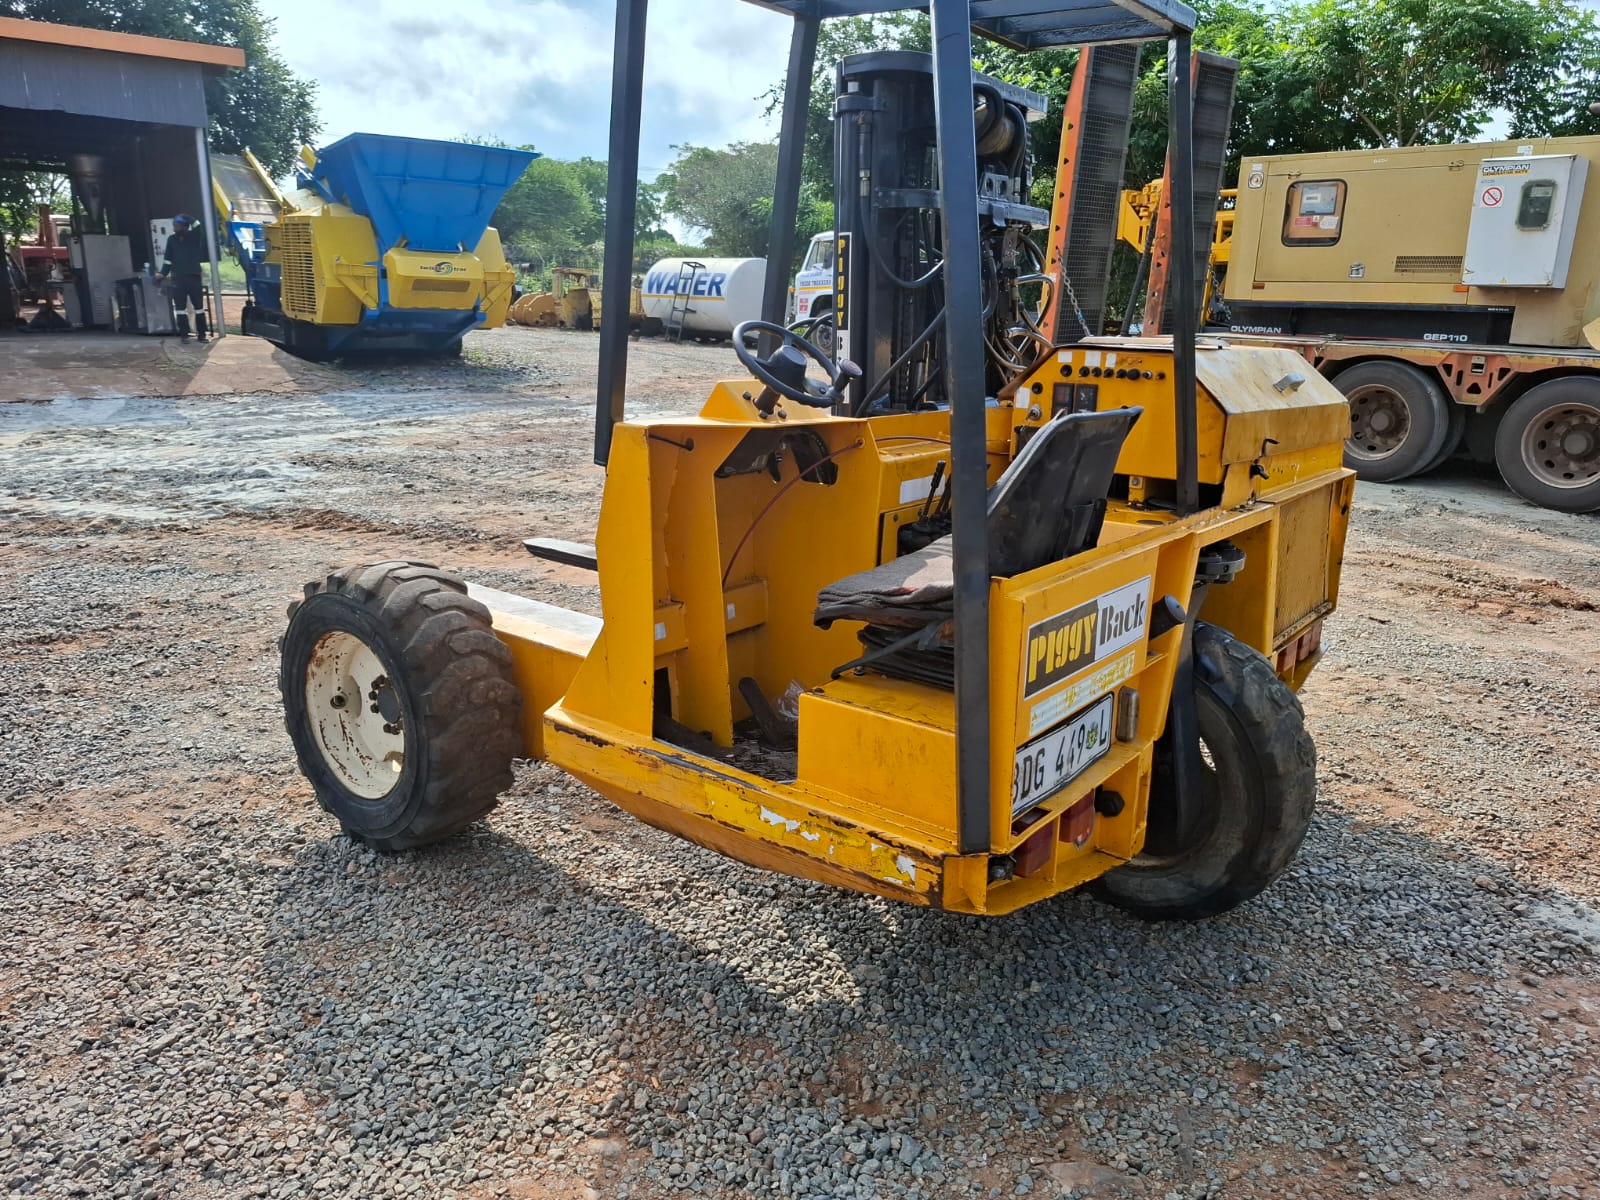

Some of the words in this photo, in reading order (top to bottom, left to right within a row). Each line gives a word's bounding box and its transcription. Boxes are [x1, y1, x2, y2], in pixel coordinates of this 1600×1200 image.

[1483, 164, 1530, 173] OLYMPIAN
[647, 271, 727, 297] WATER
[1230, 325, 1282, 334] OLYMPIAN
[1423, 333, 1468, 342] GEP110
[1099, 593, 1146, 647] Back
